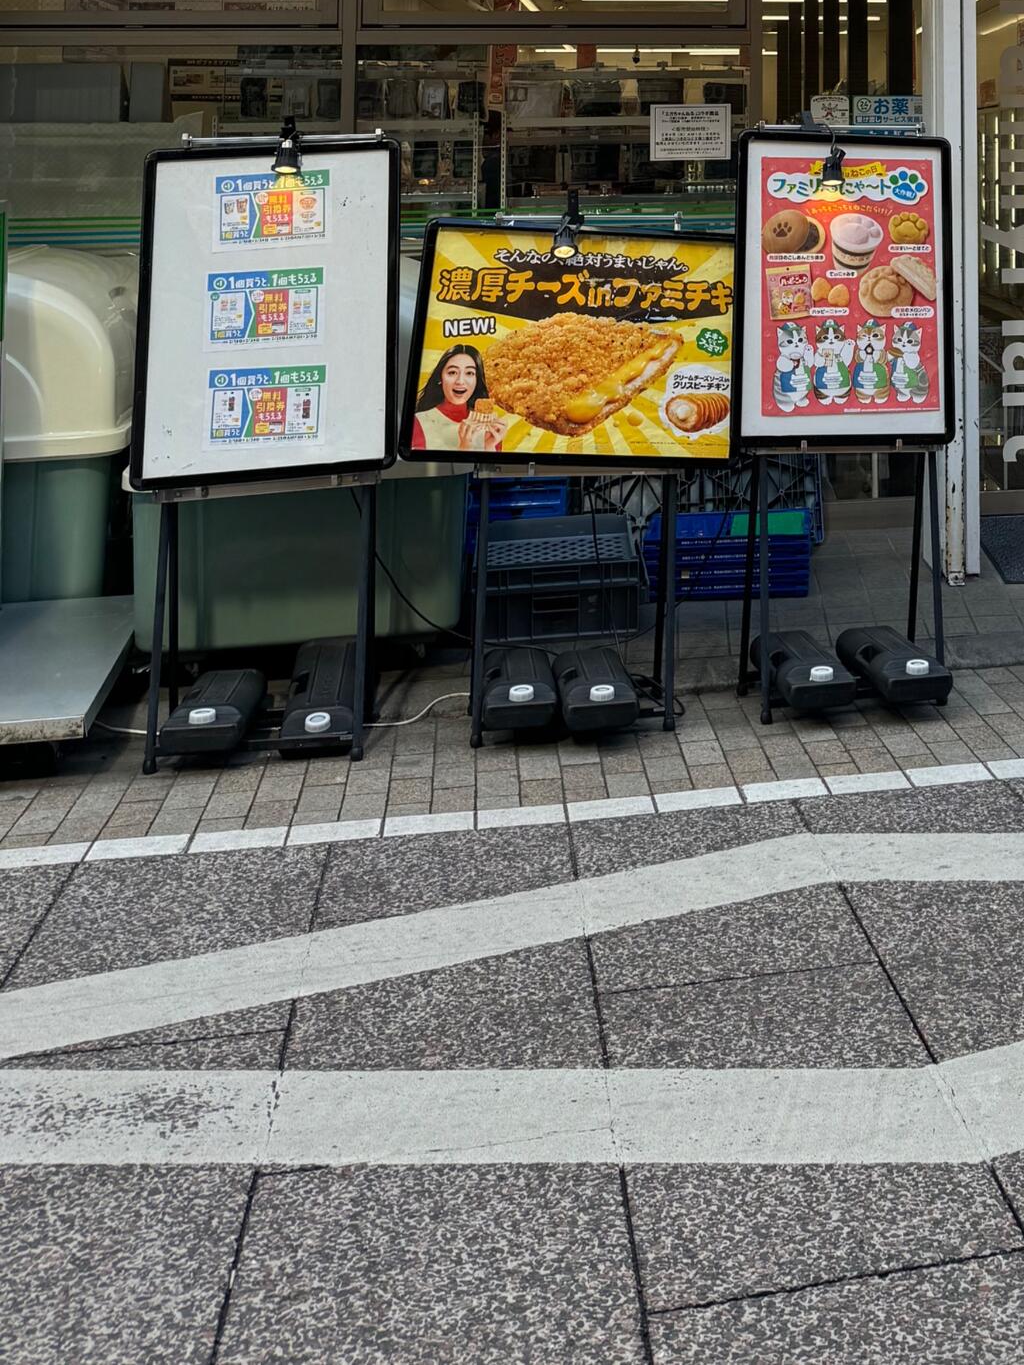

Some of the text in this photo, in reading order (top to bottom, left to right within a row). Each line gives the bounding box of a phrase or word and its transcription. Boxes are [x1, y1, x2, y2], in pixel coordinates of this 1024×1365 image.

[873, 97, 909, 115] お薬
[227, 271, 318, 290] 1個買うと、1個もらえる
[436, 267, 733, 315] 濃厚チーズinファミチキ
[443, 316, 497, 338] NEW!
[228, 369, 320, 387] 1個買うと、1個もらえる
[672, 381, 730, 392] クリスピーチキン
